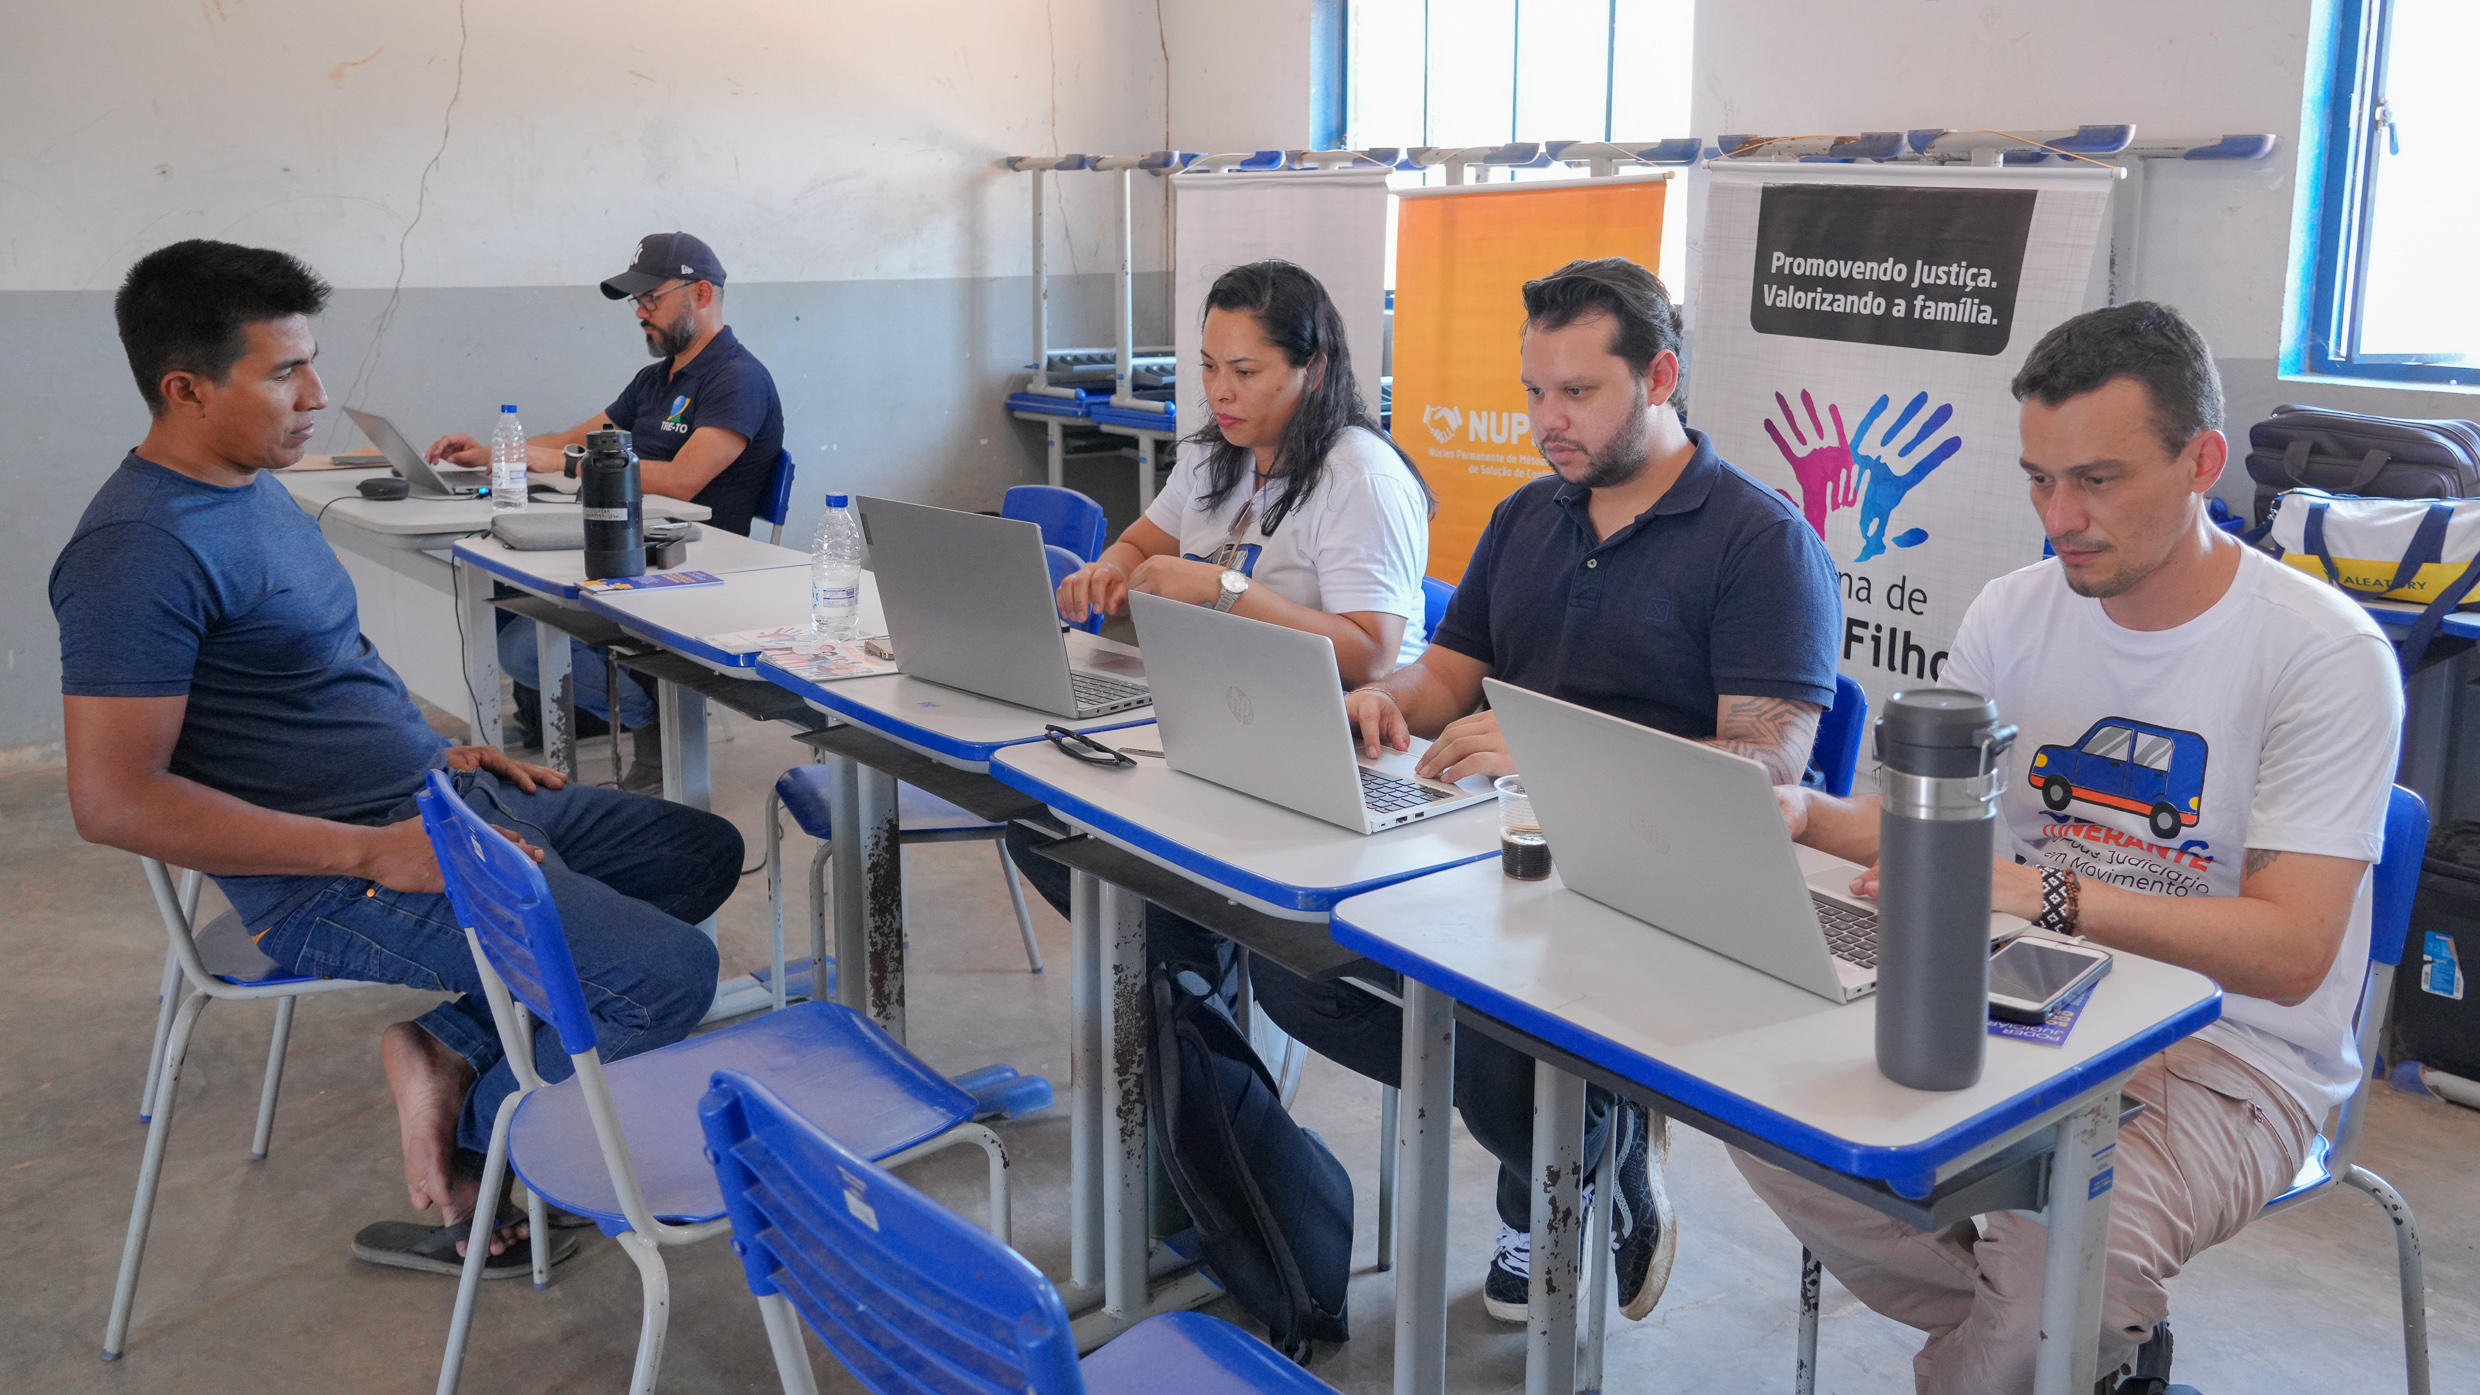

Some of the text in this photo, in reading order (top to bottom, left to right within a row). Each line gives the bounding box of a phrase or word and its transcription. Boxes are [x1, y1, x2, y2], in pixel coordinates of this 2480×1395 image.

[1770, 251, 1998, 291] Promovendo Justiça.
[1763, 284, 1998, 325] Valorizando a família.
[1469, 410, 1535, 446] NUP
[1429, 447, 1455, 458] Núcleo
[1456, 449, 1505, 463] Permanente
[1507, 454, 1517, 464] de
[1469, 464, 1479, 474] de
[1481, 464, 1513, 478] Solução
[1514, 468, 1525, 478] de
[1838, 571, 1928, 616] na de
[2343, 576, 2427, 590] ALEATRY
[1843, 616, 1949, 683] Filho
[2069, 857, 2189, 897] Movimento
[1987, 1020, 2065, 1035] JUDICIÁR
[2002, 1028, 2060, 1042] PODER
